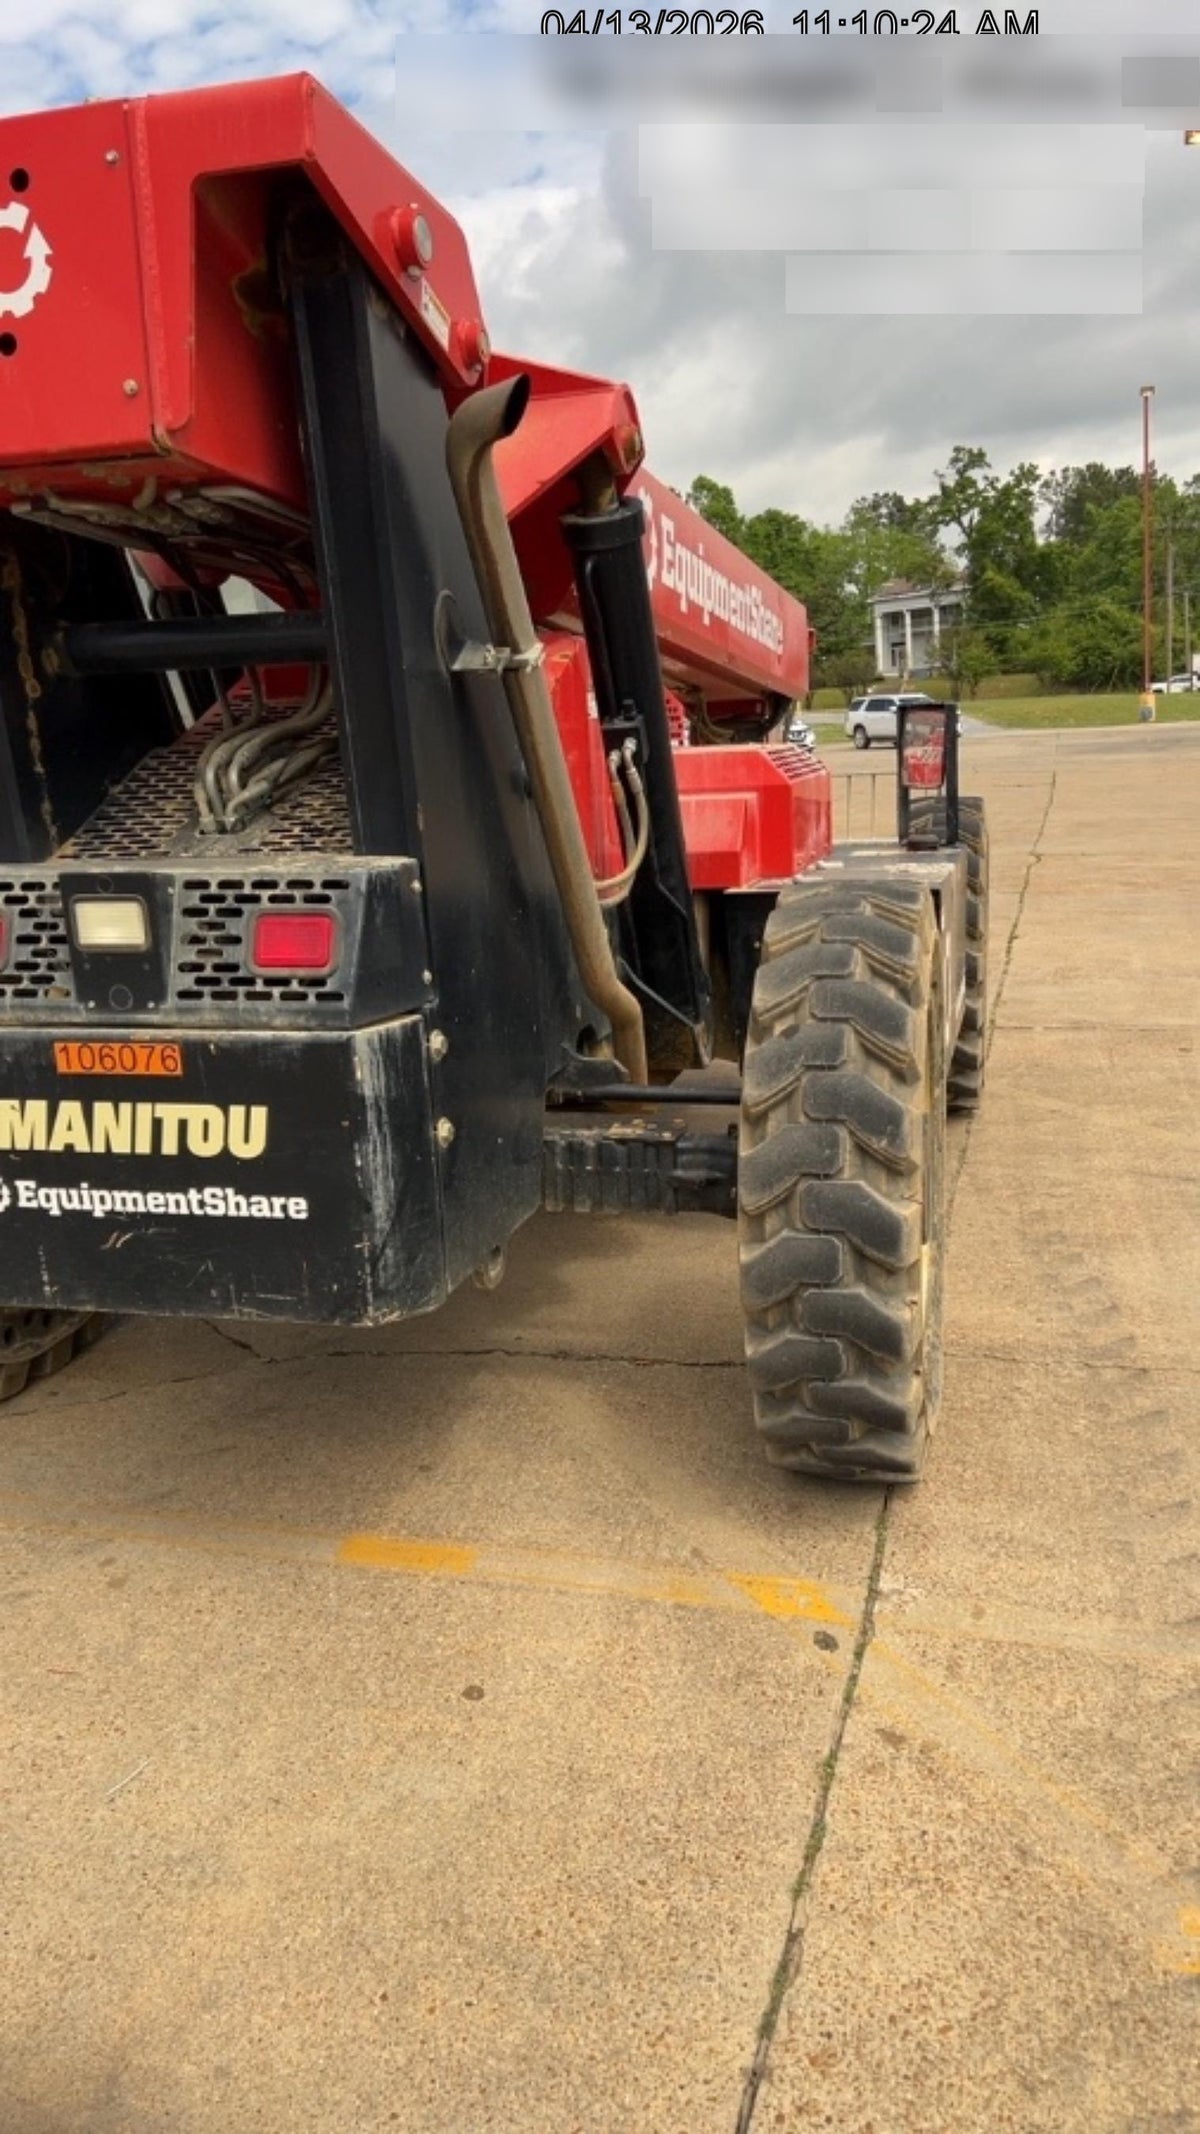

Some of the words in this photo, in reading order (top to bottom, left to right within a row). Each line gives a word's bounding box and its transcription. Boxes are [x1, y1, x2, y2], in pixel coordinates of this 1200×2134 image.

[661, 513, 783, 655] EquipmentShare
[58, 1044, 180, 1073] 106076
[0, 1099, 268, 1159] MANITOU
[14, 1179, 309, 1219] EquipmentShare
